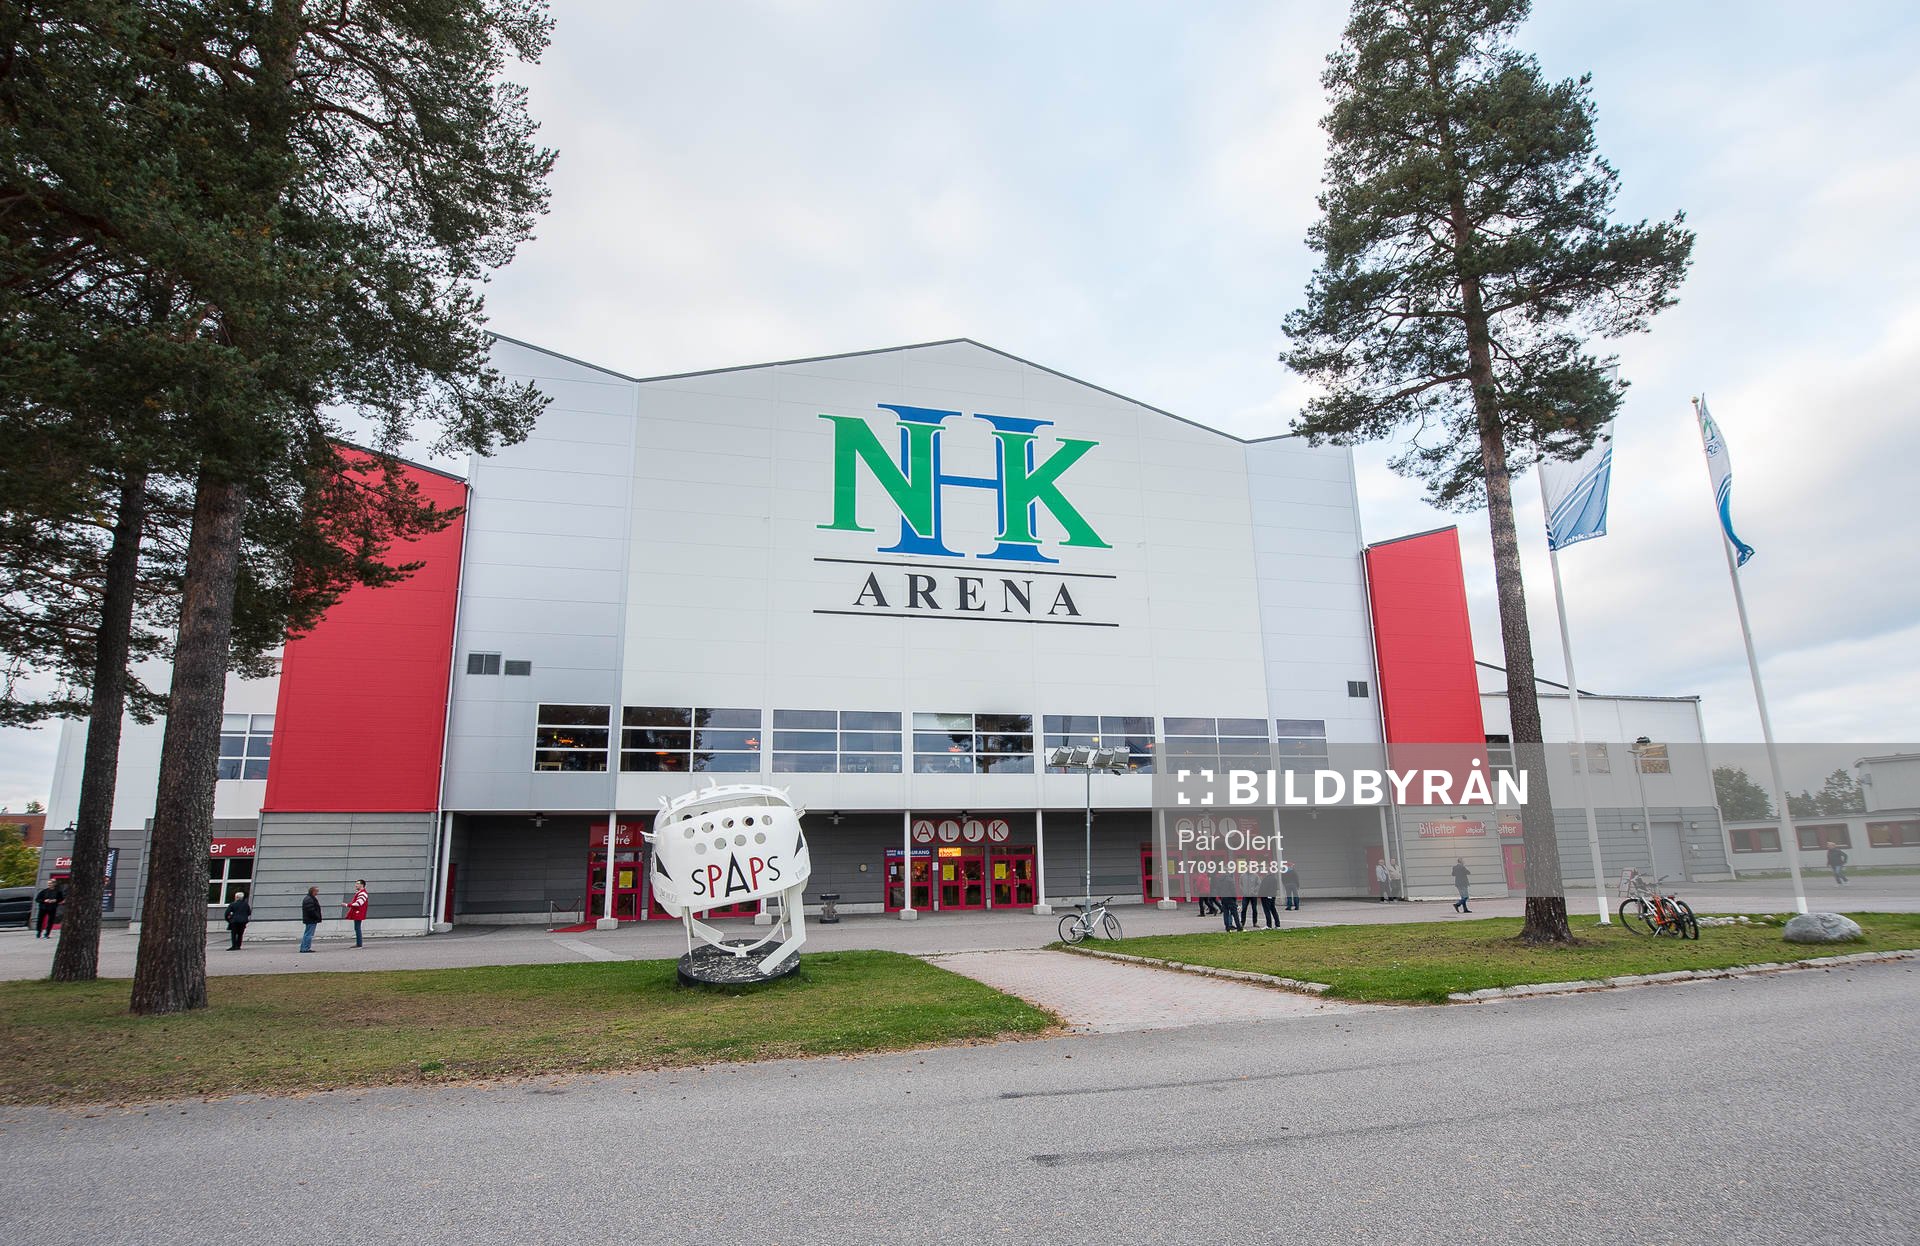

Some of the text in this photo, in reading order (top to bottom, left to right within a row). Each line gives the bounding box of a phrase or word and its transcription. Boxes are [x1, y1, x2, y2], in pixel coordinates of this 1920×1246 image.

[816, 403, 1114, 564] NHK
[852, 571, 1082, 617] ARENA
[917, 822, 1004, 839] A L J K
[1420, 821, 1457, 837] Biljetter
[603, 835, 631, 845] Etré
[56, 857, 72, 866] Entr
[691, 851, 781, 898] SPAPS
